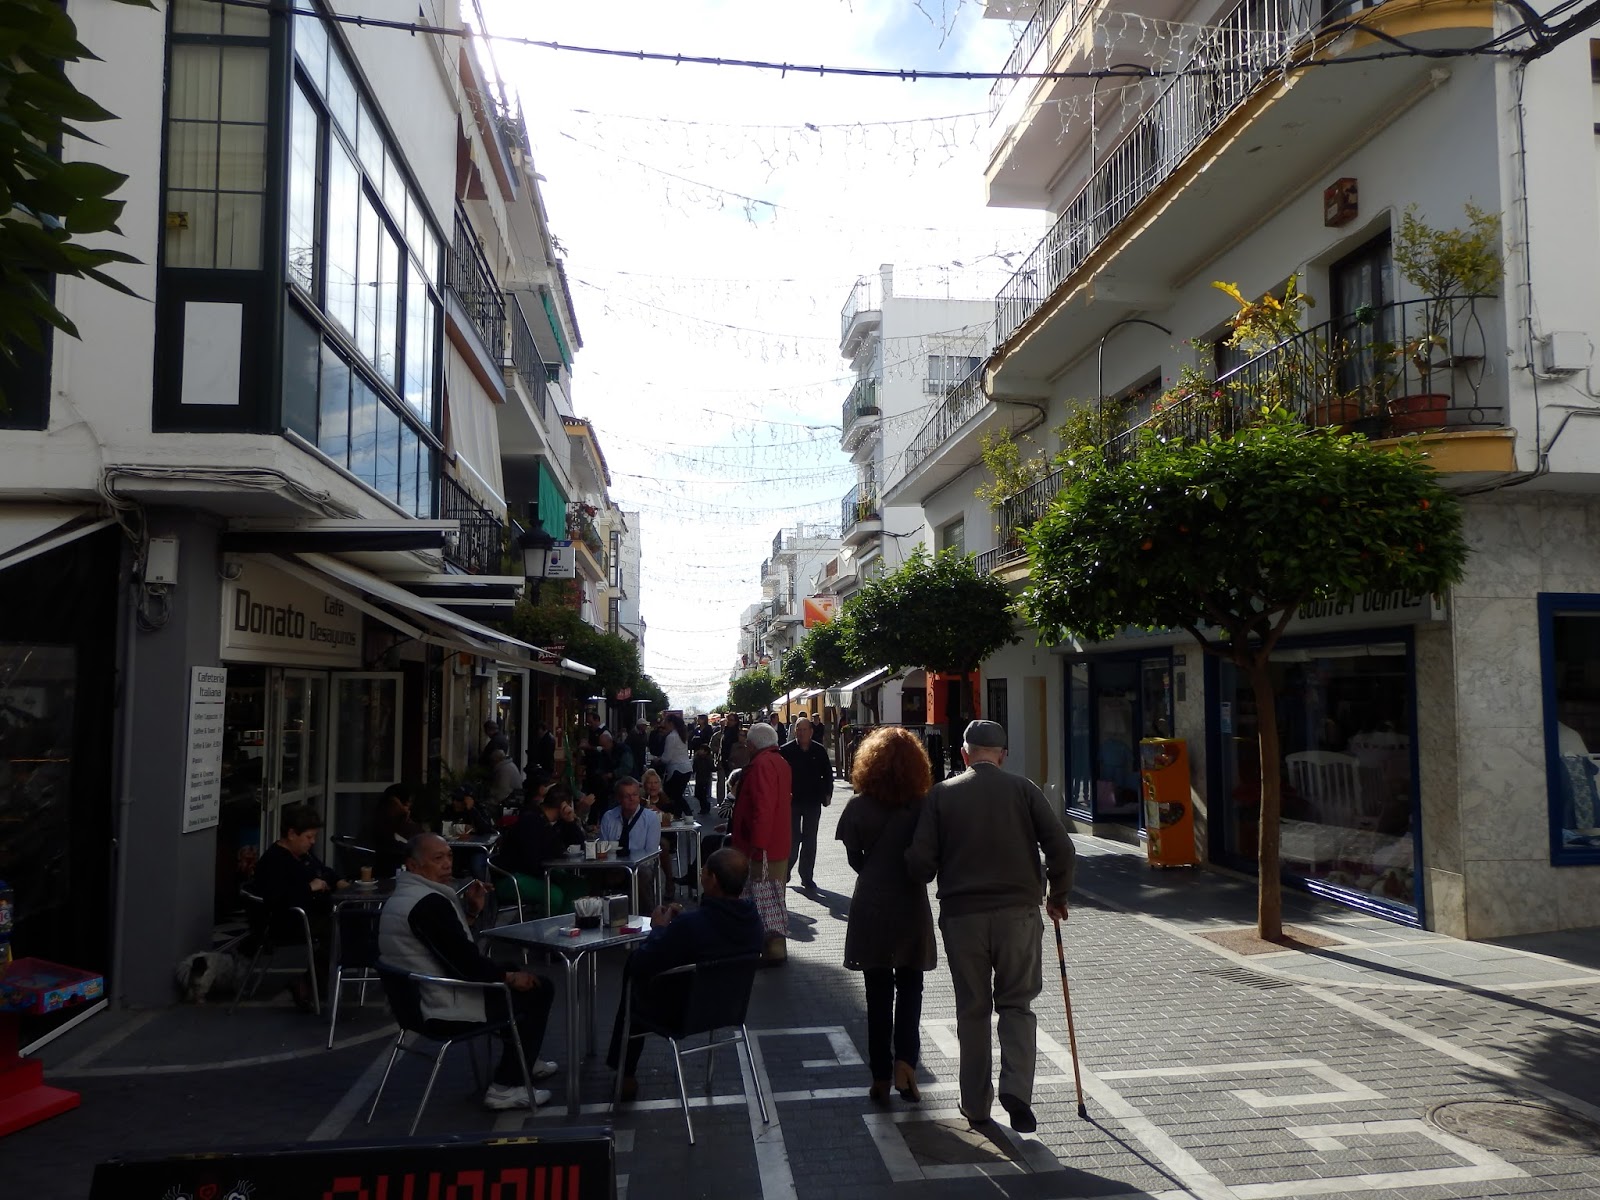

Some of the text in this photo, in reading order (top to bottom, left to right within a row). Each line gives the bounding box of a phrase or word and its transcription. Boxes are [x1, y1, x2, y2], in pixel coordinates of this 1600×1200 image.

[235, 588, 304, 639] Donato
[310, 621, 356, 648] Desayunos
[199, 687, 222, 697] Italiana
